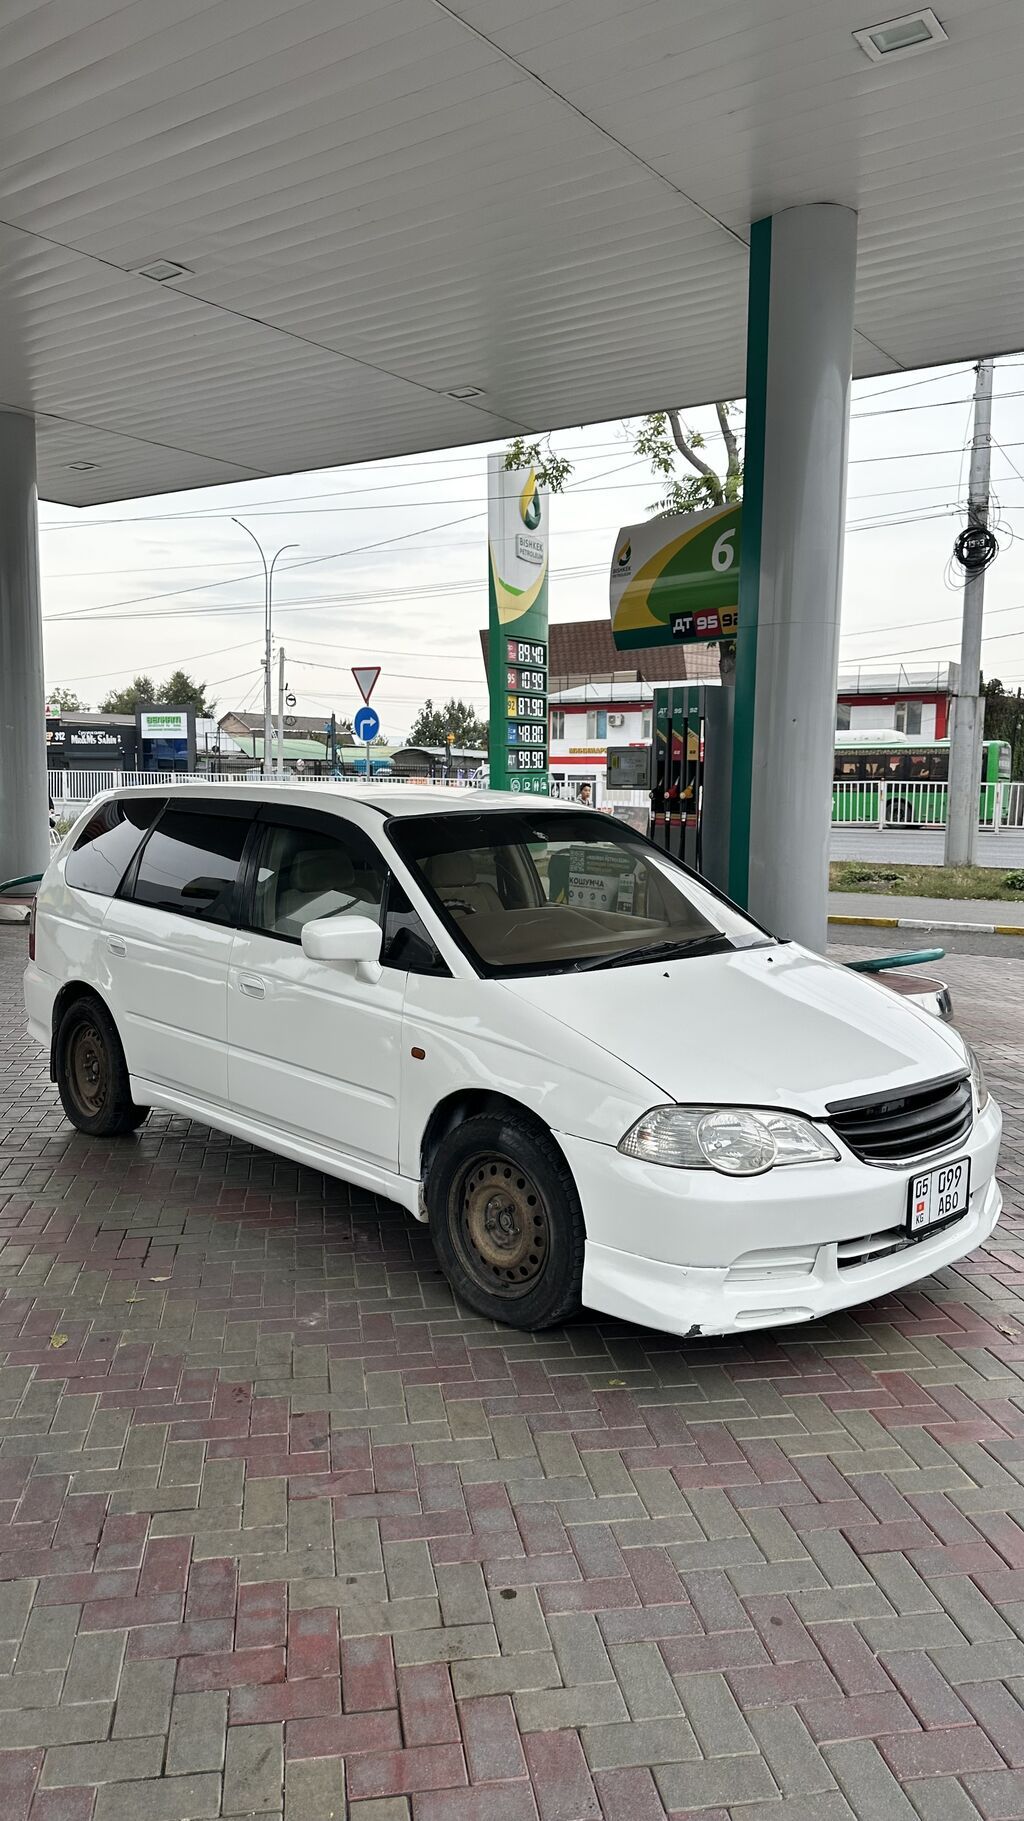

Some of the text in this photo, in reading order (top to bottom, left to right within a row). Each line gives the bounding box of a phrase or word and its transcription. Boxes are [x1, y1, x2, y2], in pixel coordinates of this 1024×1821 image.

[519, 537, 544, 552] BISHKEK
[711, 527, 736, 573] 6
[519, 548, 544, 560] PETROLEUM
[612, 565, 631, 574] BISHKEK
[672, 617, 693, 634] ДТ
[696, 615, 719, 630] 95
[518, 643, 544, 664] 89.40
[507, 672, 516, 684] 95
[507, 697, 544, 716] 92 87.90
[518, 725, 544, 743] 48.80
[518, 751, 544, 769] 99.90
[570, 877, 604, 888] КОШУМЧА
[915, 1177, 929, 1199] 05
[938, 1165, 962, 1194] 099
[915, 1212, 924, 1224] KG
